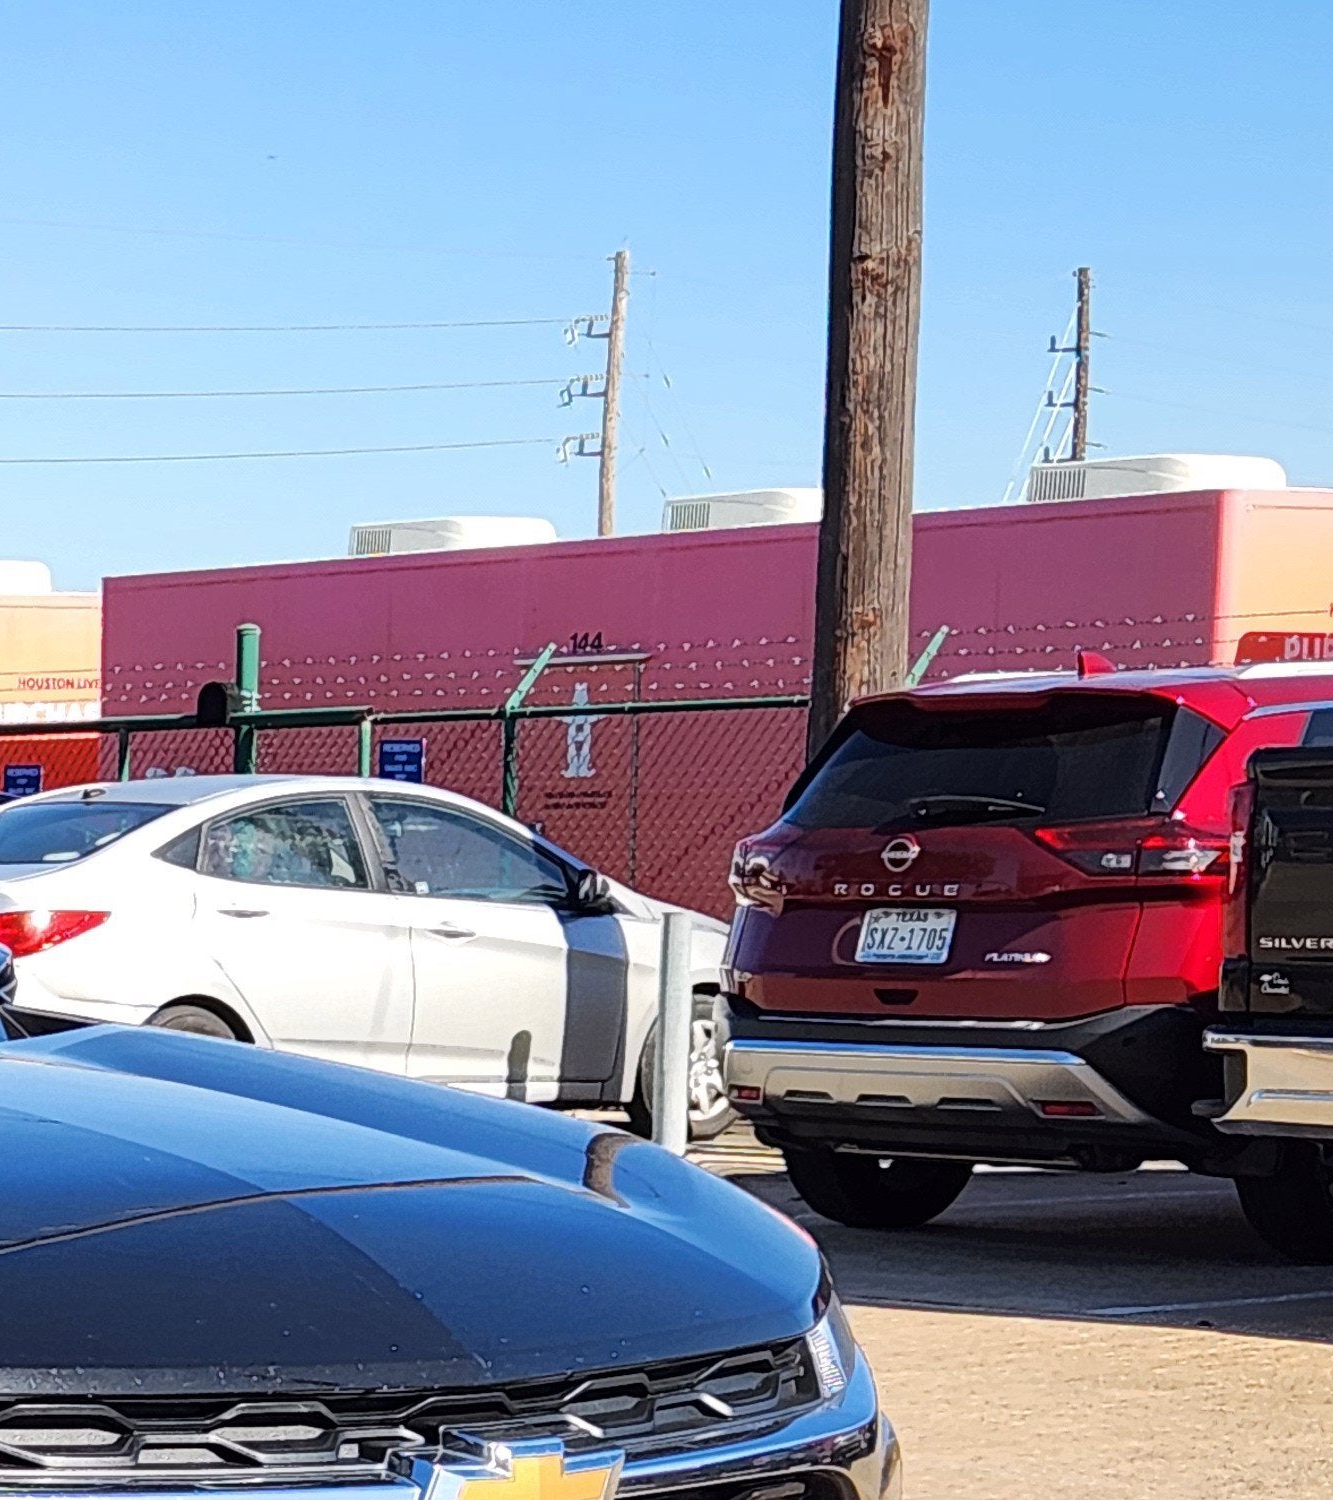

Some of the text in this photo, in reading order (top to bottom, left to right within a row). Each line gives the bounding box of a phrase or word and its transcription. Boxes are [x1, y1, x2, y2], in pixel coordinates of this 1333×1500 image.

[570, 631, 603, 654] 144
[18, 678, 74, 690] HOUSTON
[1259, 937, 1333, 949] SILVER
